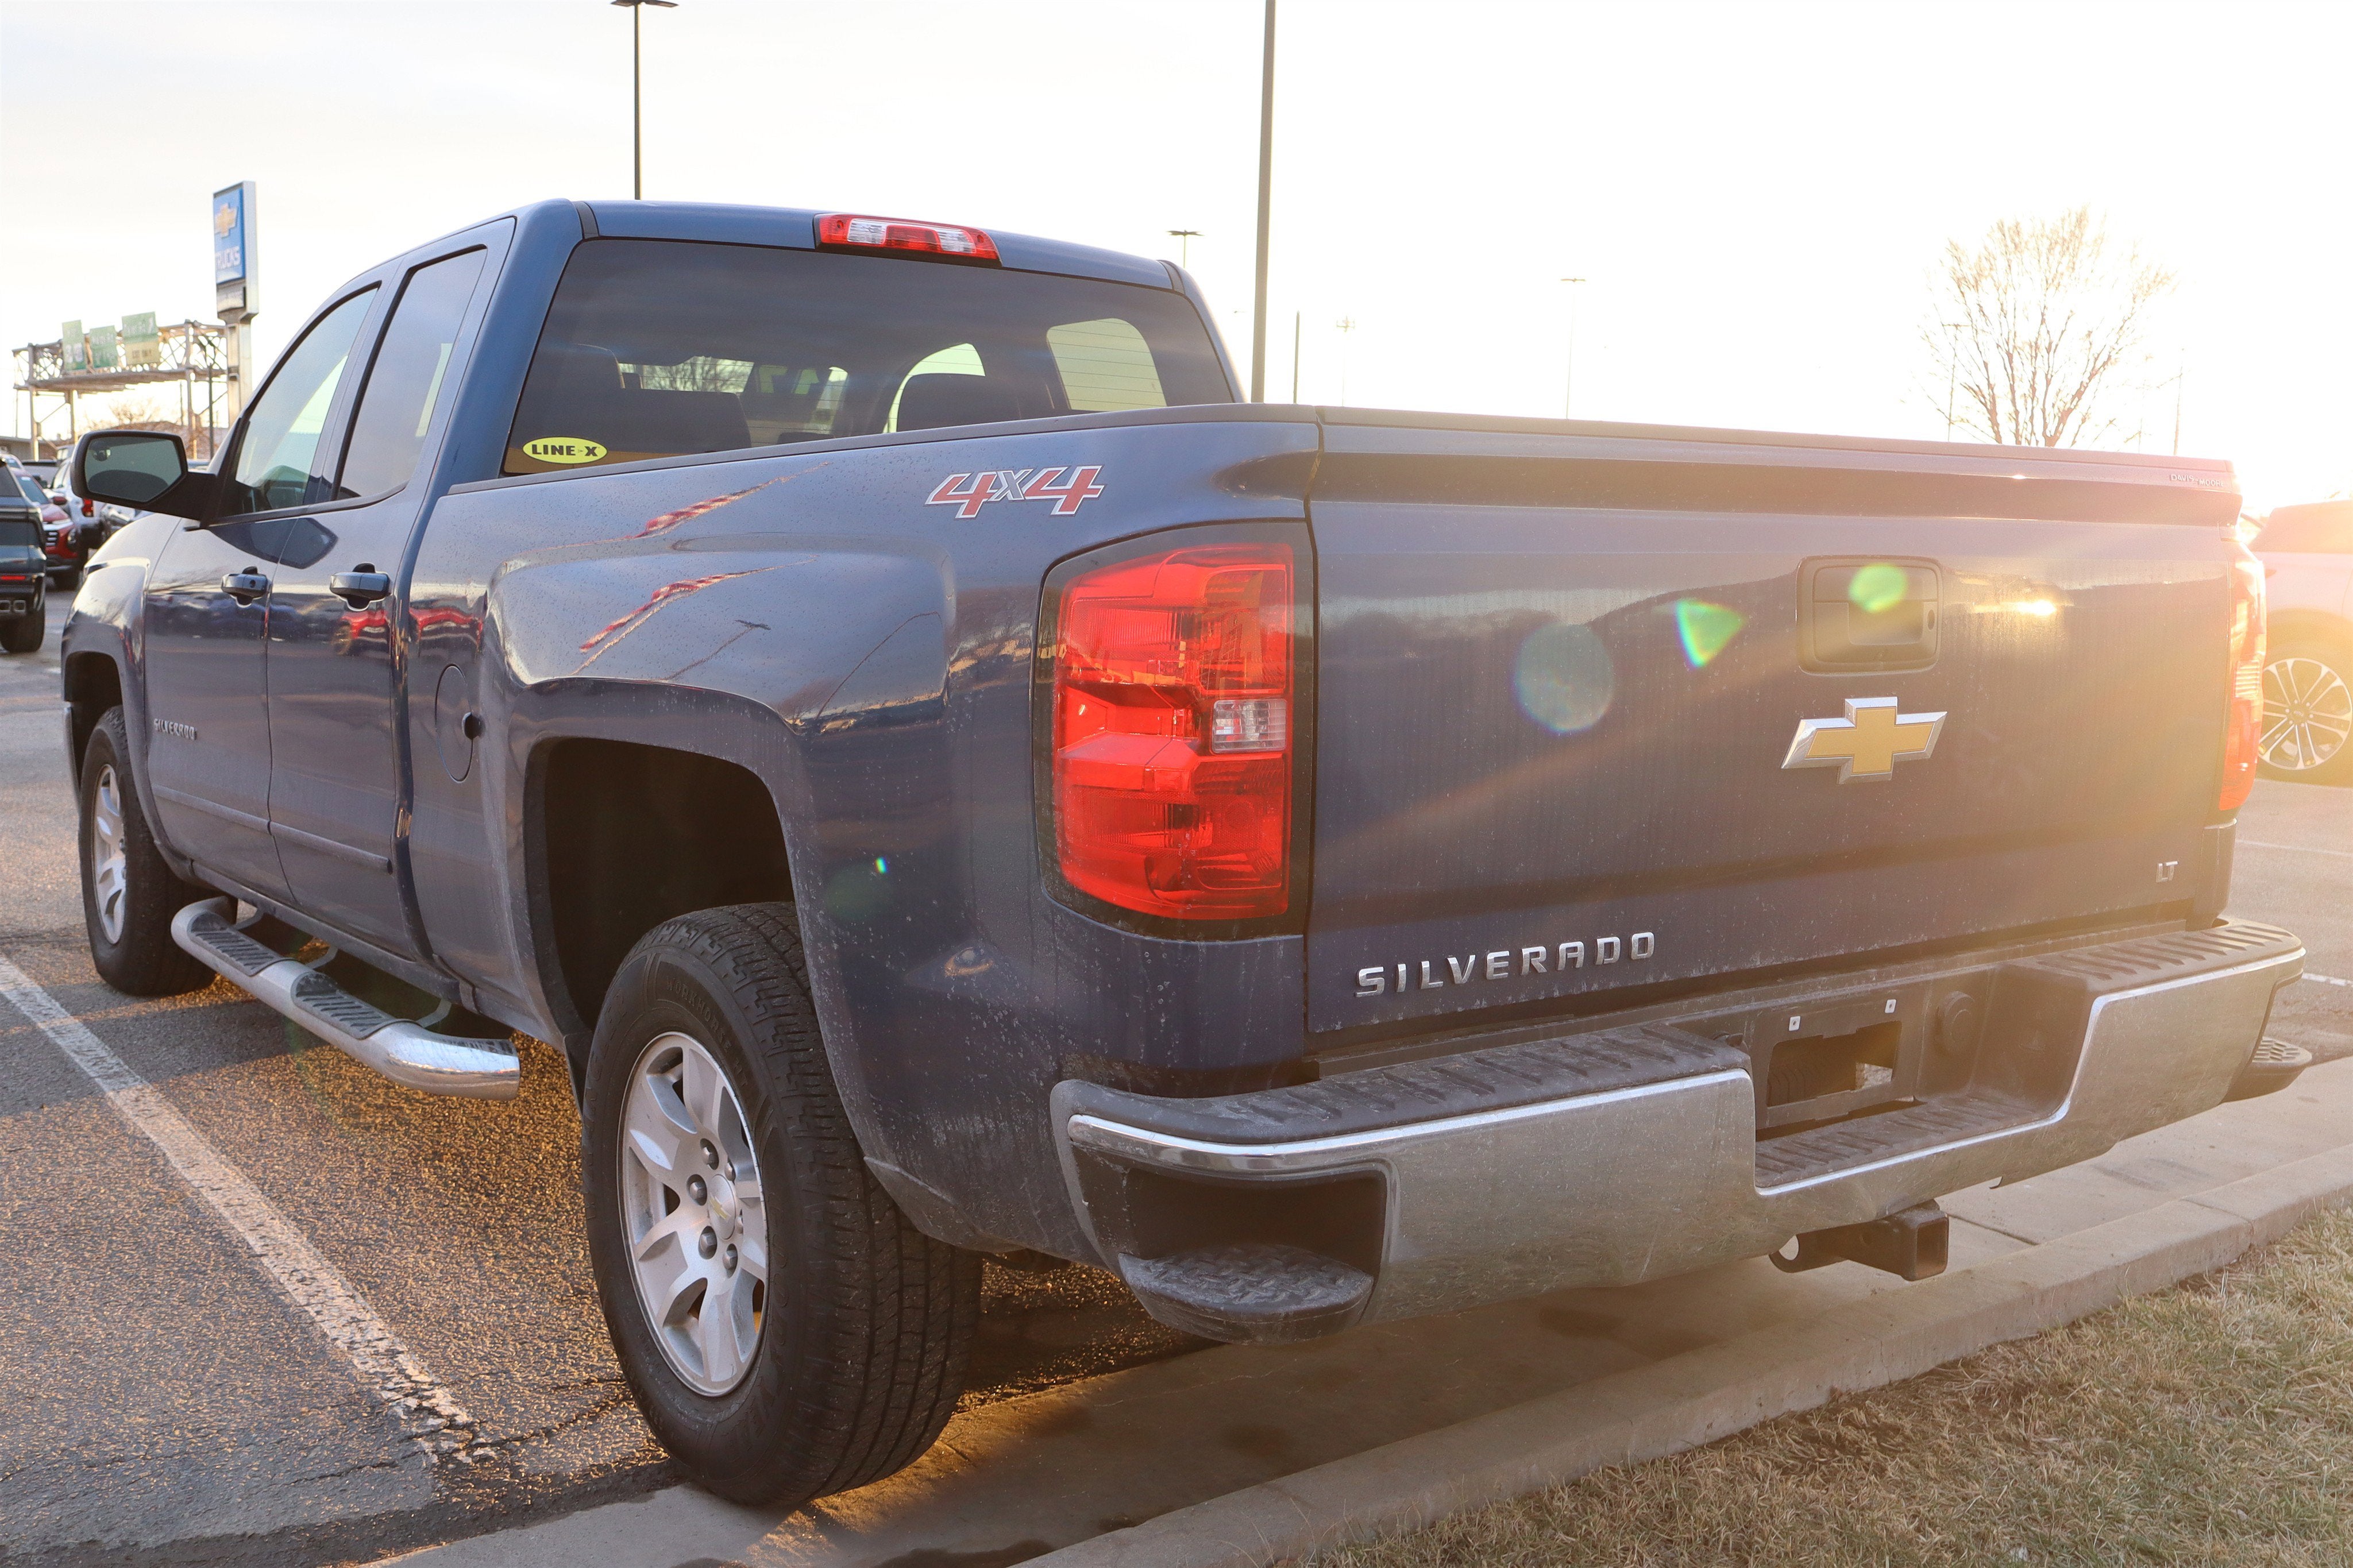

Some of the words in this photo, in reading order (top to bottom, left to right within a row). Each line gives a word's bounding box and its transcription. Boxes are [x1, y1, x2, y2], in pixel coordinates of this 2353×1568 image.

[153, 719, 198, 741] SILVERADO
[2155, 861, 2178, 883] LT
[1355, 932, 1655, 998] SILVERADO
